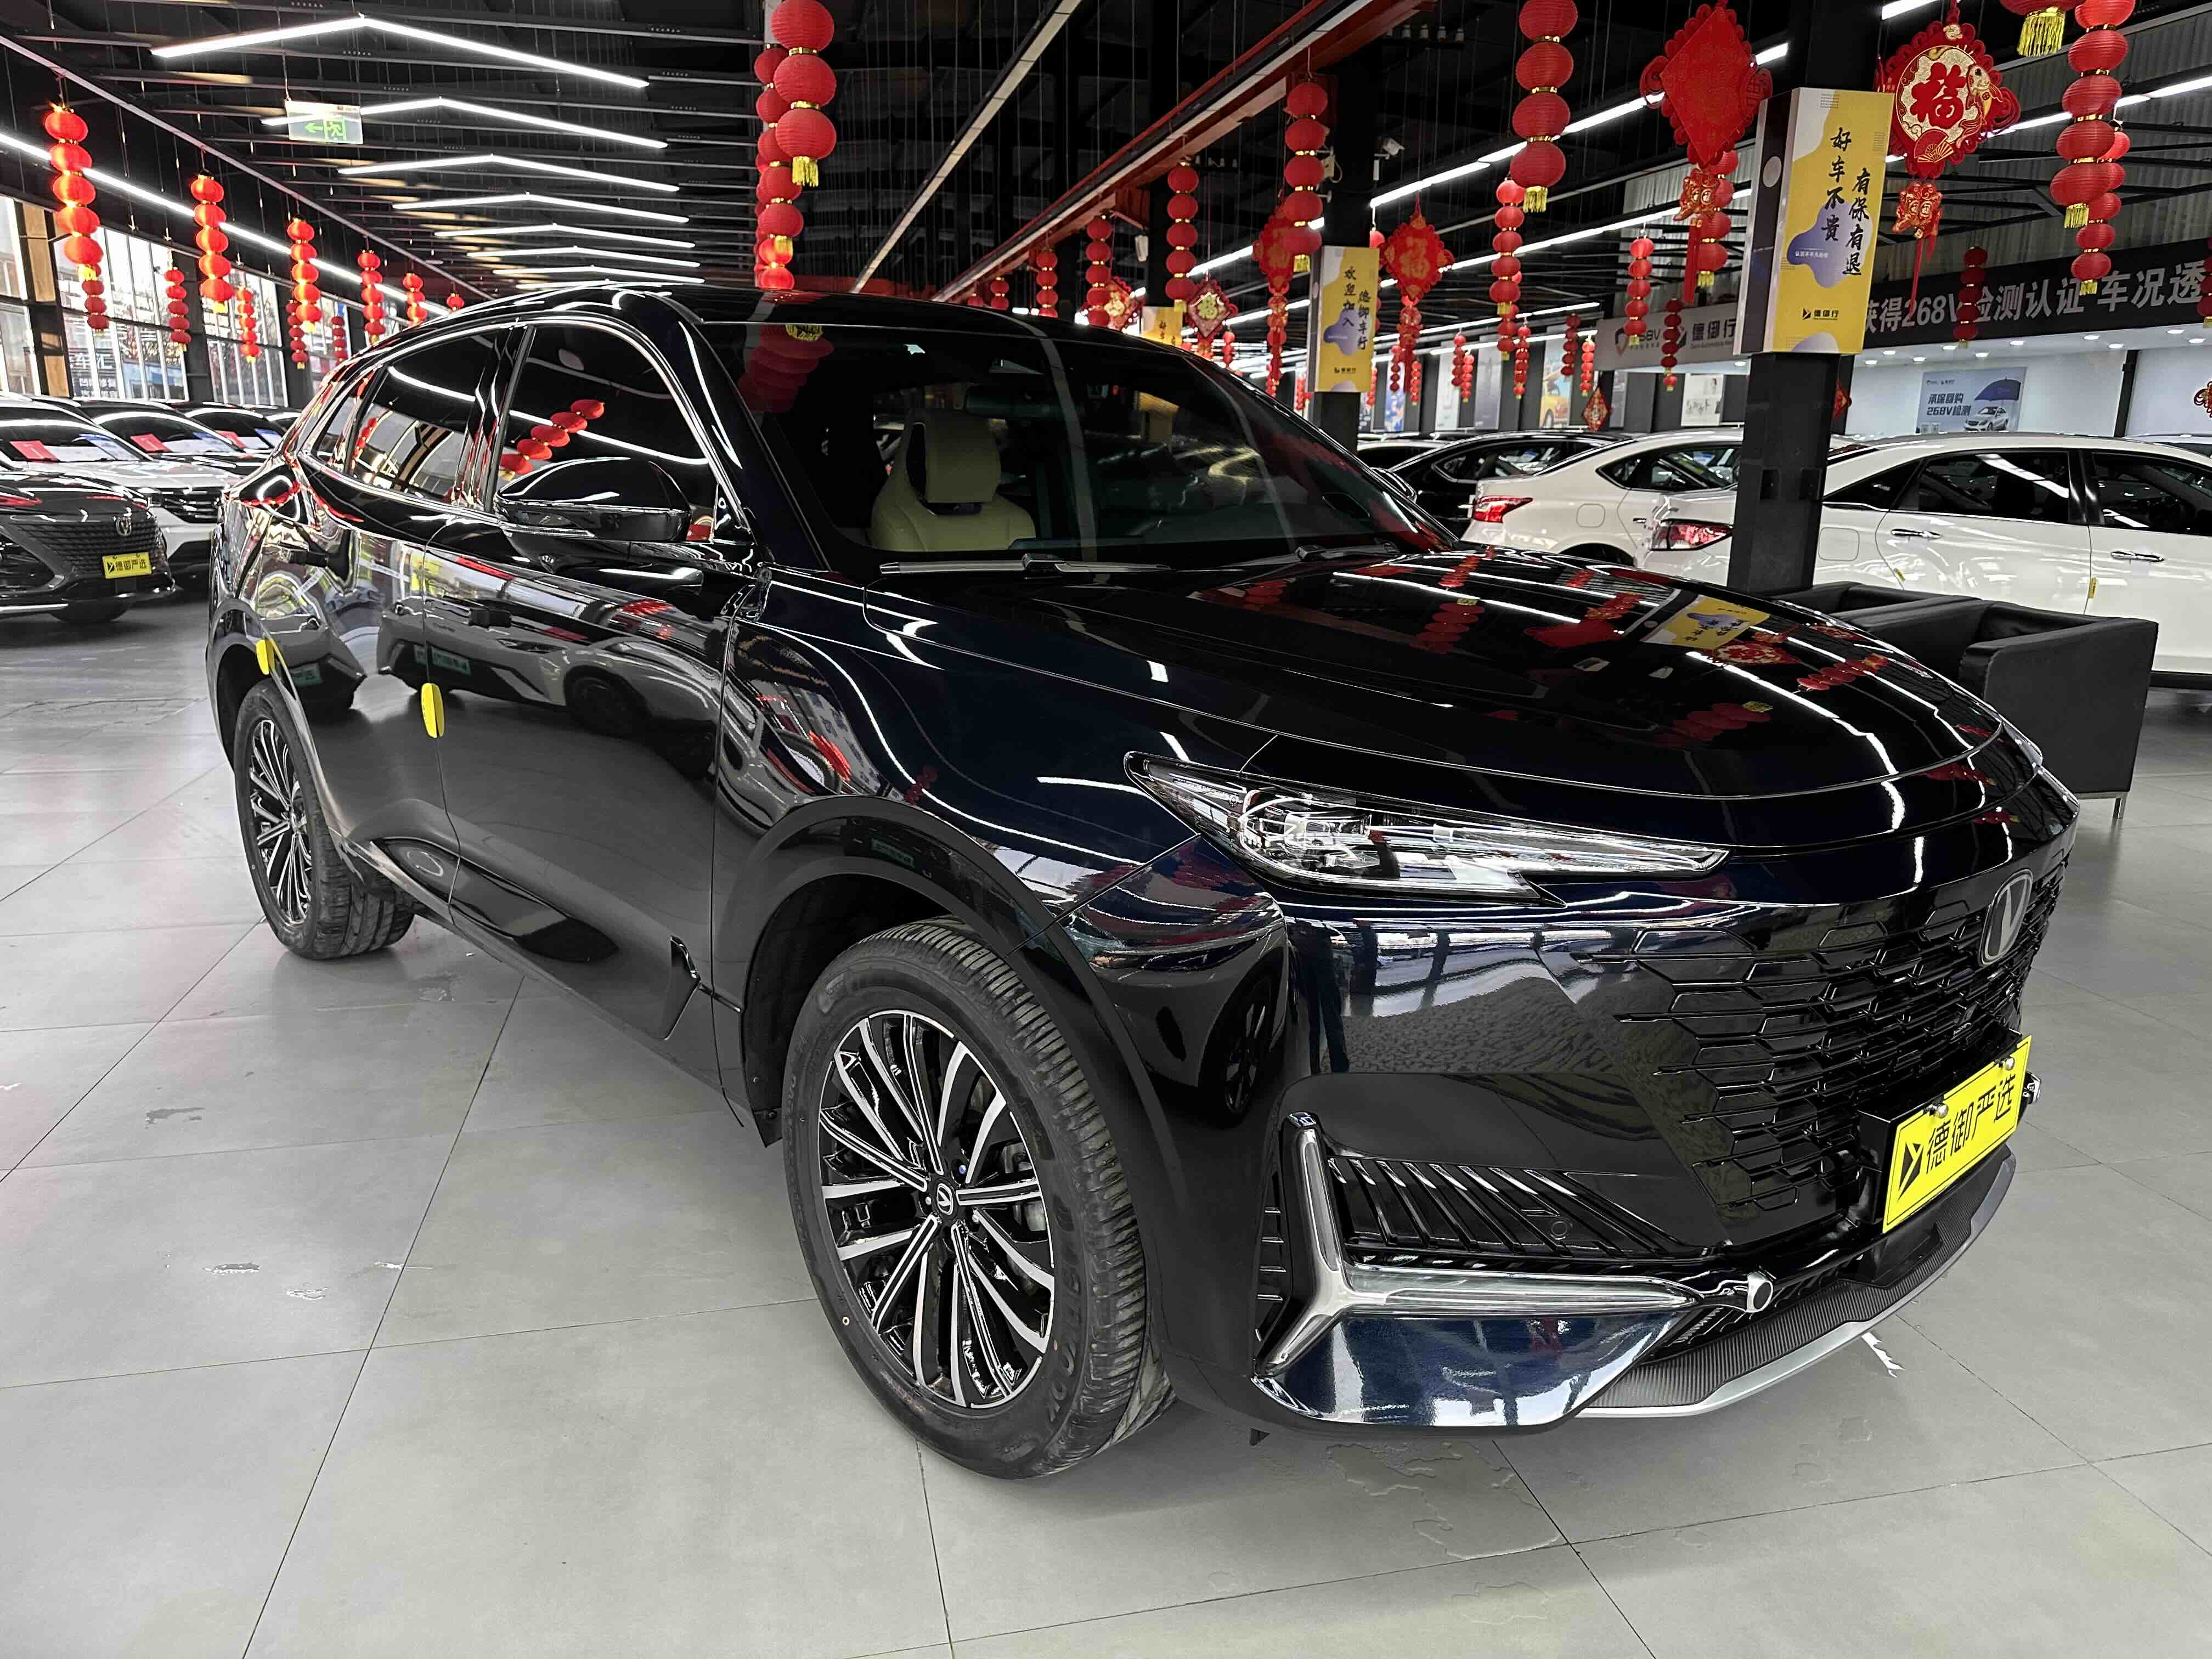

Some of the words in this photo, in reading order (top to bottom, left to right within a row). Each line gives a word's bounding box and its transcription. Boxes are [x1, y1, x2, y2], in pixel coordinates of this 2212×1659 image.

[1910, 62, 1967, 129] 福
[1821, 127, 1852, 241] 好车不贵
[1842, 167, 1870, 275] 有保有退
[1343, 266, 1357, 327] 欢迎加入
[1926, 404, 1971, 416] 268V检测
[1928, 393, 1963, 404] 承保回购
[1926, 1073, 2016, 1175] 德御严选
